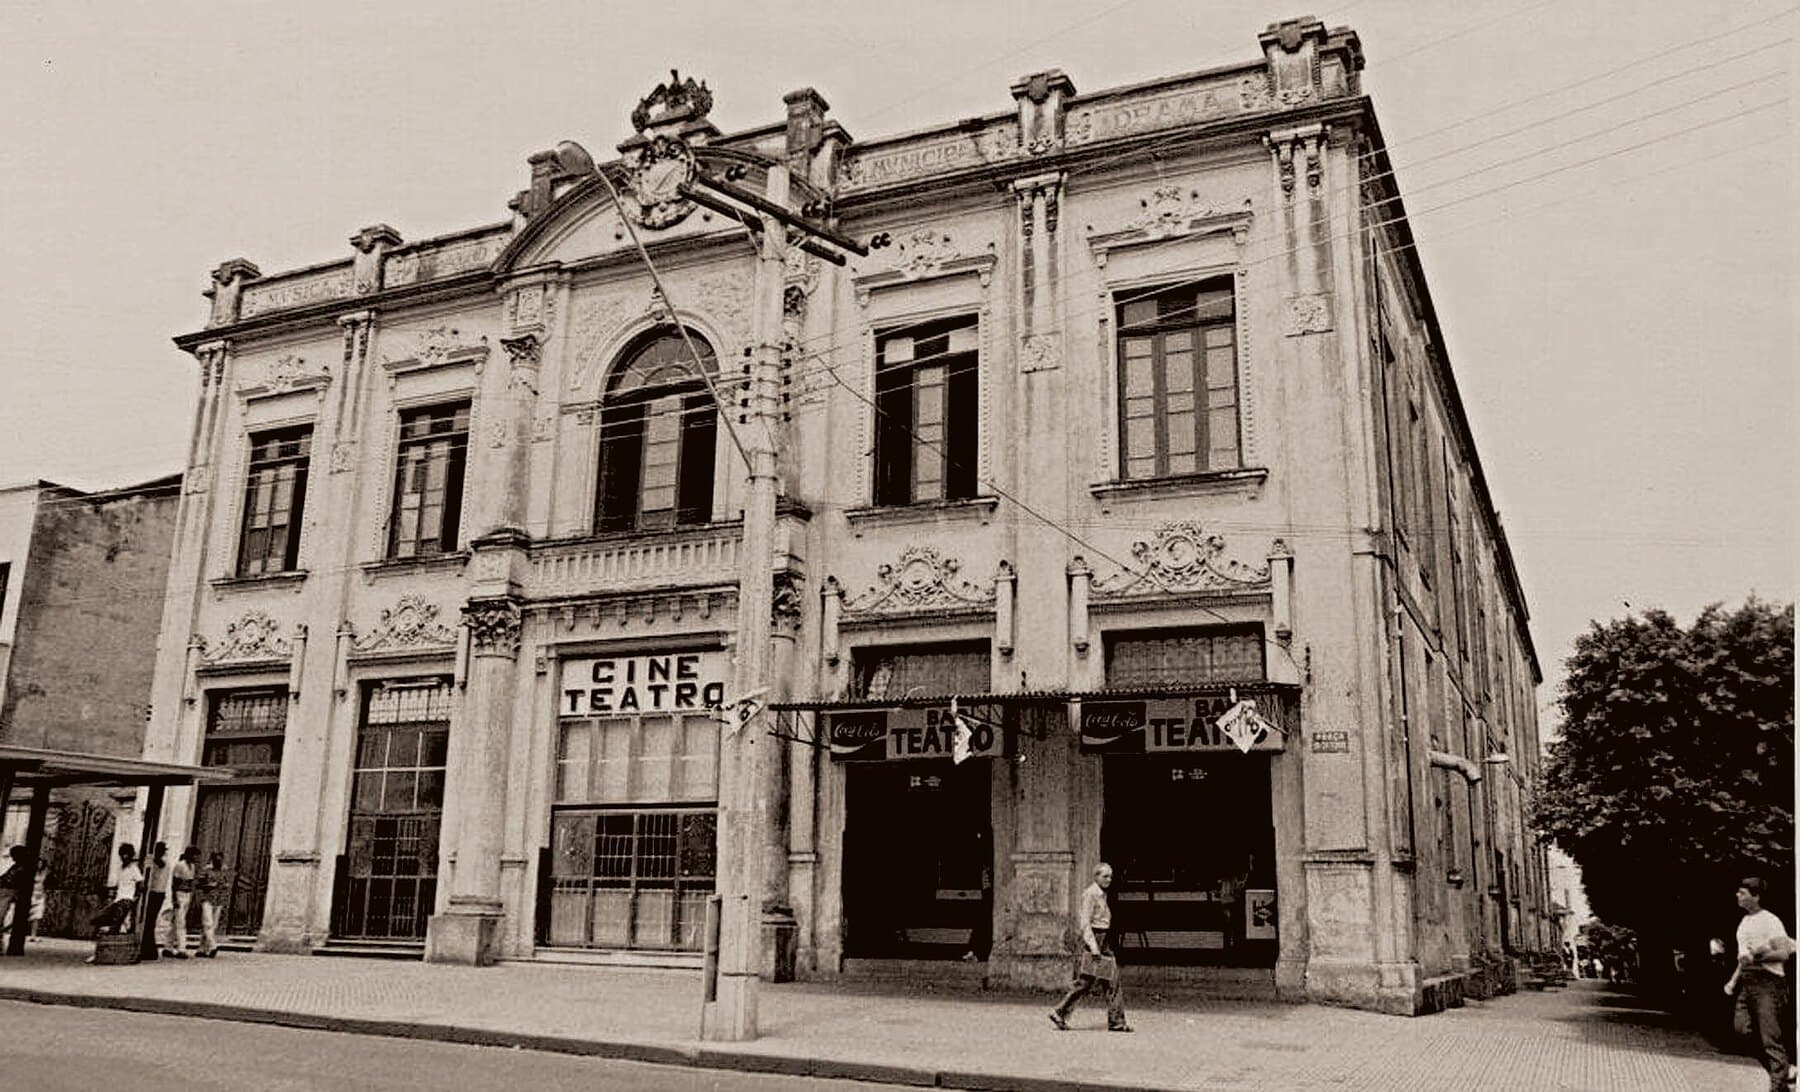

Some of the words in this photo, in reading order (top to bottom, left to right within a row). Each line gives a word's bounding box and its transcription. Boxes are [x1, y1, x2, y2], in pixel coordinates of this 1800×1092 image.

[592, 655, 699, 684] CINE
[564, 682, 724, 712] TEATRO
[1195, 699, 1236, 718] BA
[889, 723, 995, 755] TEATO
